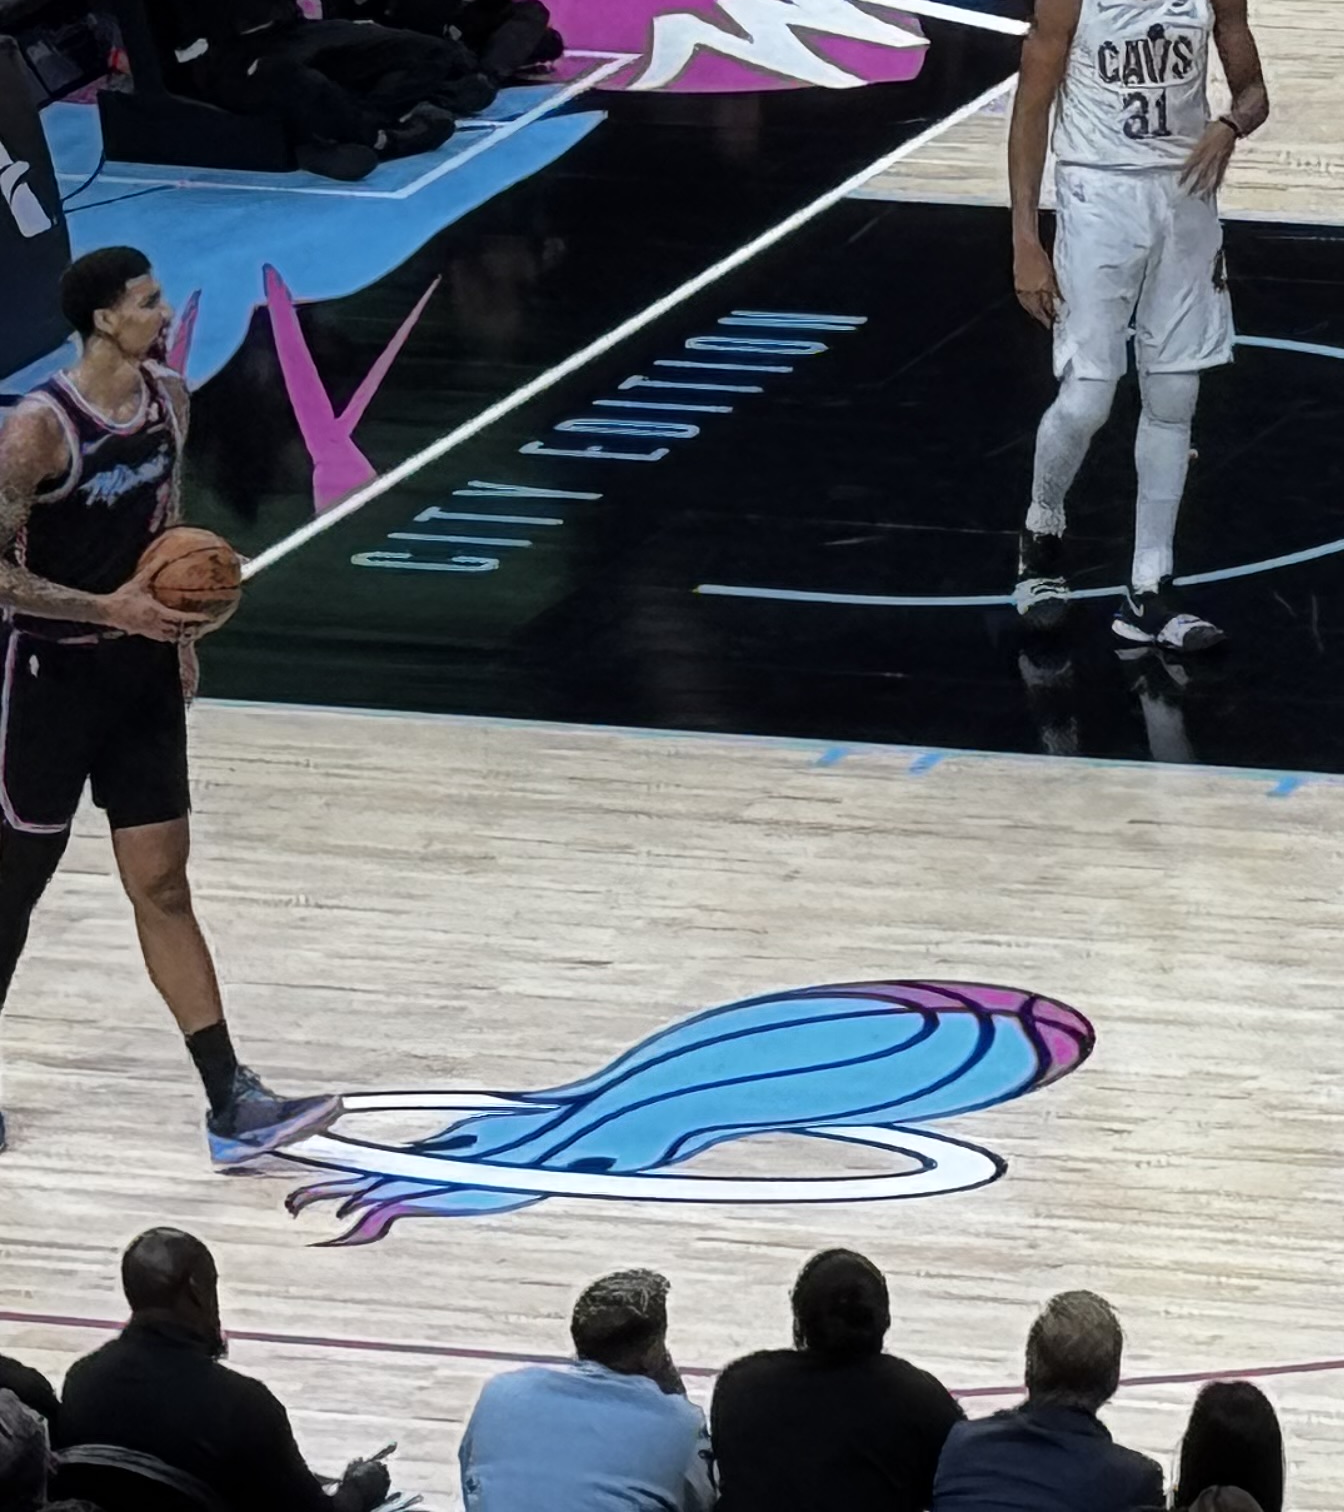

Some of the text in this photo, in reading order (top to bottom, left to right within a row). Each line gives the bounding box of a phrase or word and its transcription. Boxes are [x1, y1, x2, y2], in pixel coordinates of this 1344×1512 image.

[1097, 23, 1195, 85] CAVS
[1122, 88, 1172, 140] 31
[350, 479, 603, 572] CITY
